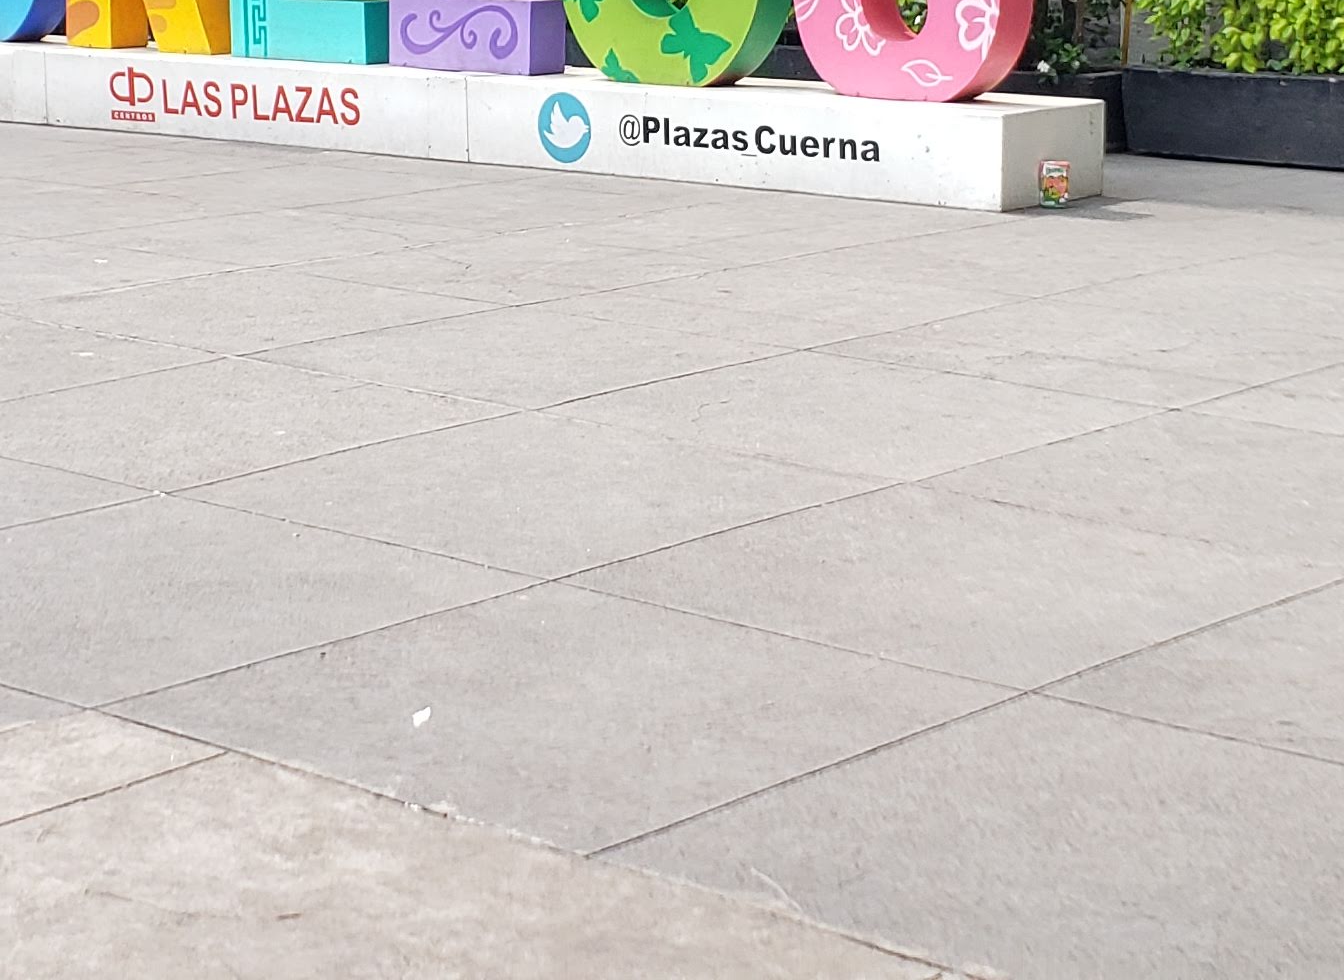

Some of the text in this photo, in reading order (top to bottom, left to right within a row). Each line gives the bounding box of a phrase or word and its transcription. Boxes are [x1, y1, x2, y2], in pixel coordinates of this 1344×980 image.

[113, 111, 154, 121] CENTROS
[162, 78, 361, 126] LAS PLAZAS
